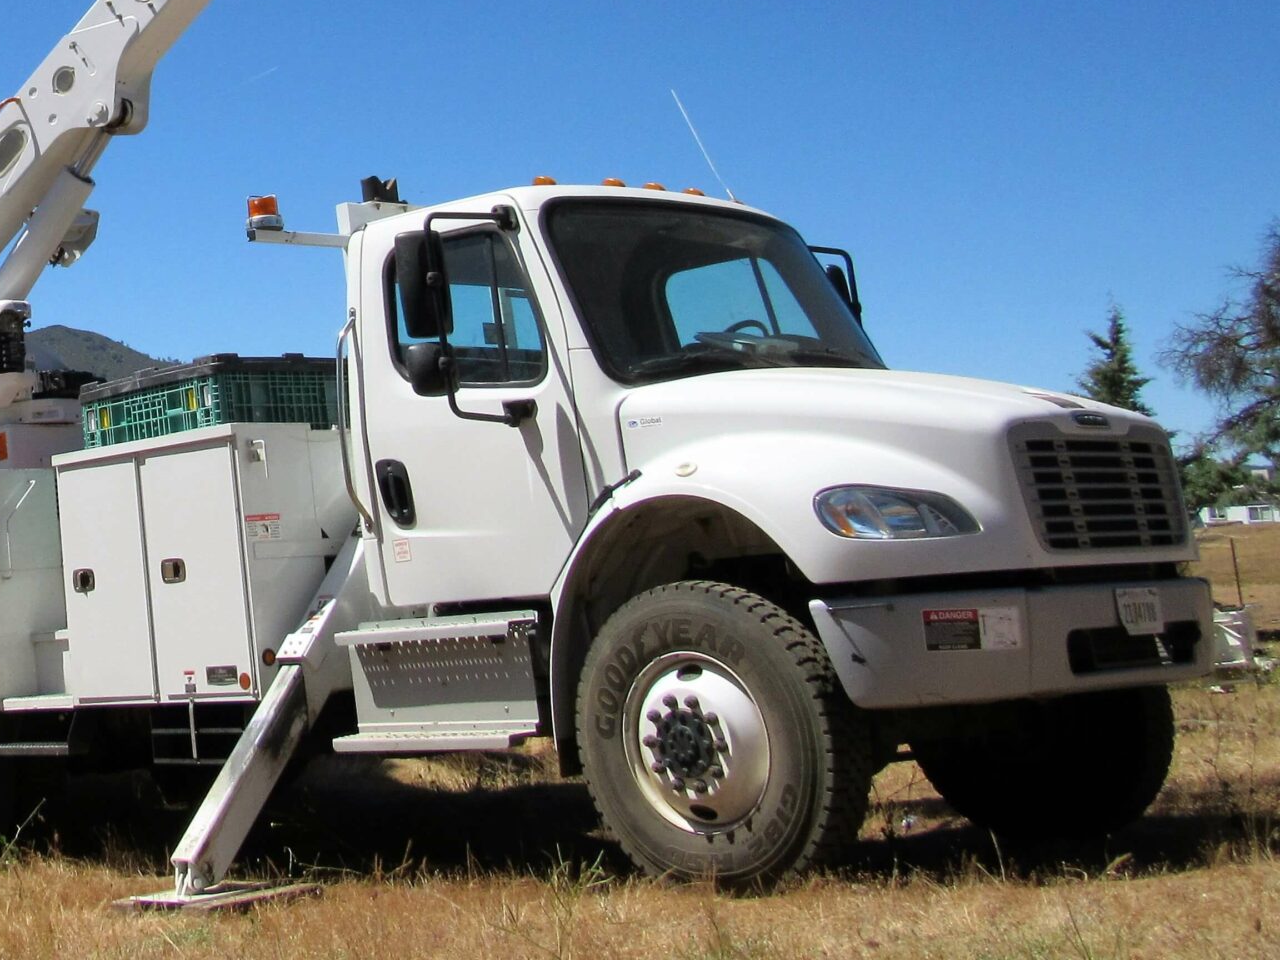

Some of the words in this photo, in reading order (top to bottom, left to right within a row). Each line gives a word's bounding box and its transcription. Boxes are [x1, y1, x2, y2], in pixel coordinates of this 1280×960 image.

[639, 416, 662, 425] Global
[939, 610, 974, 620] DANGER
[594, 618, 746, 740] GOODYEAR
